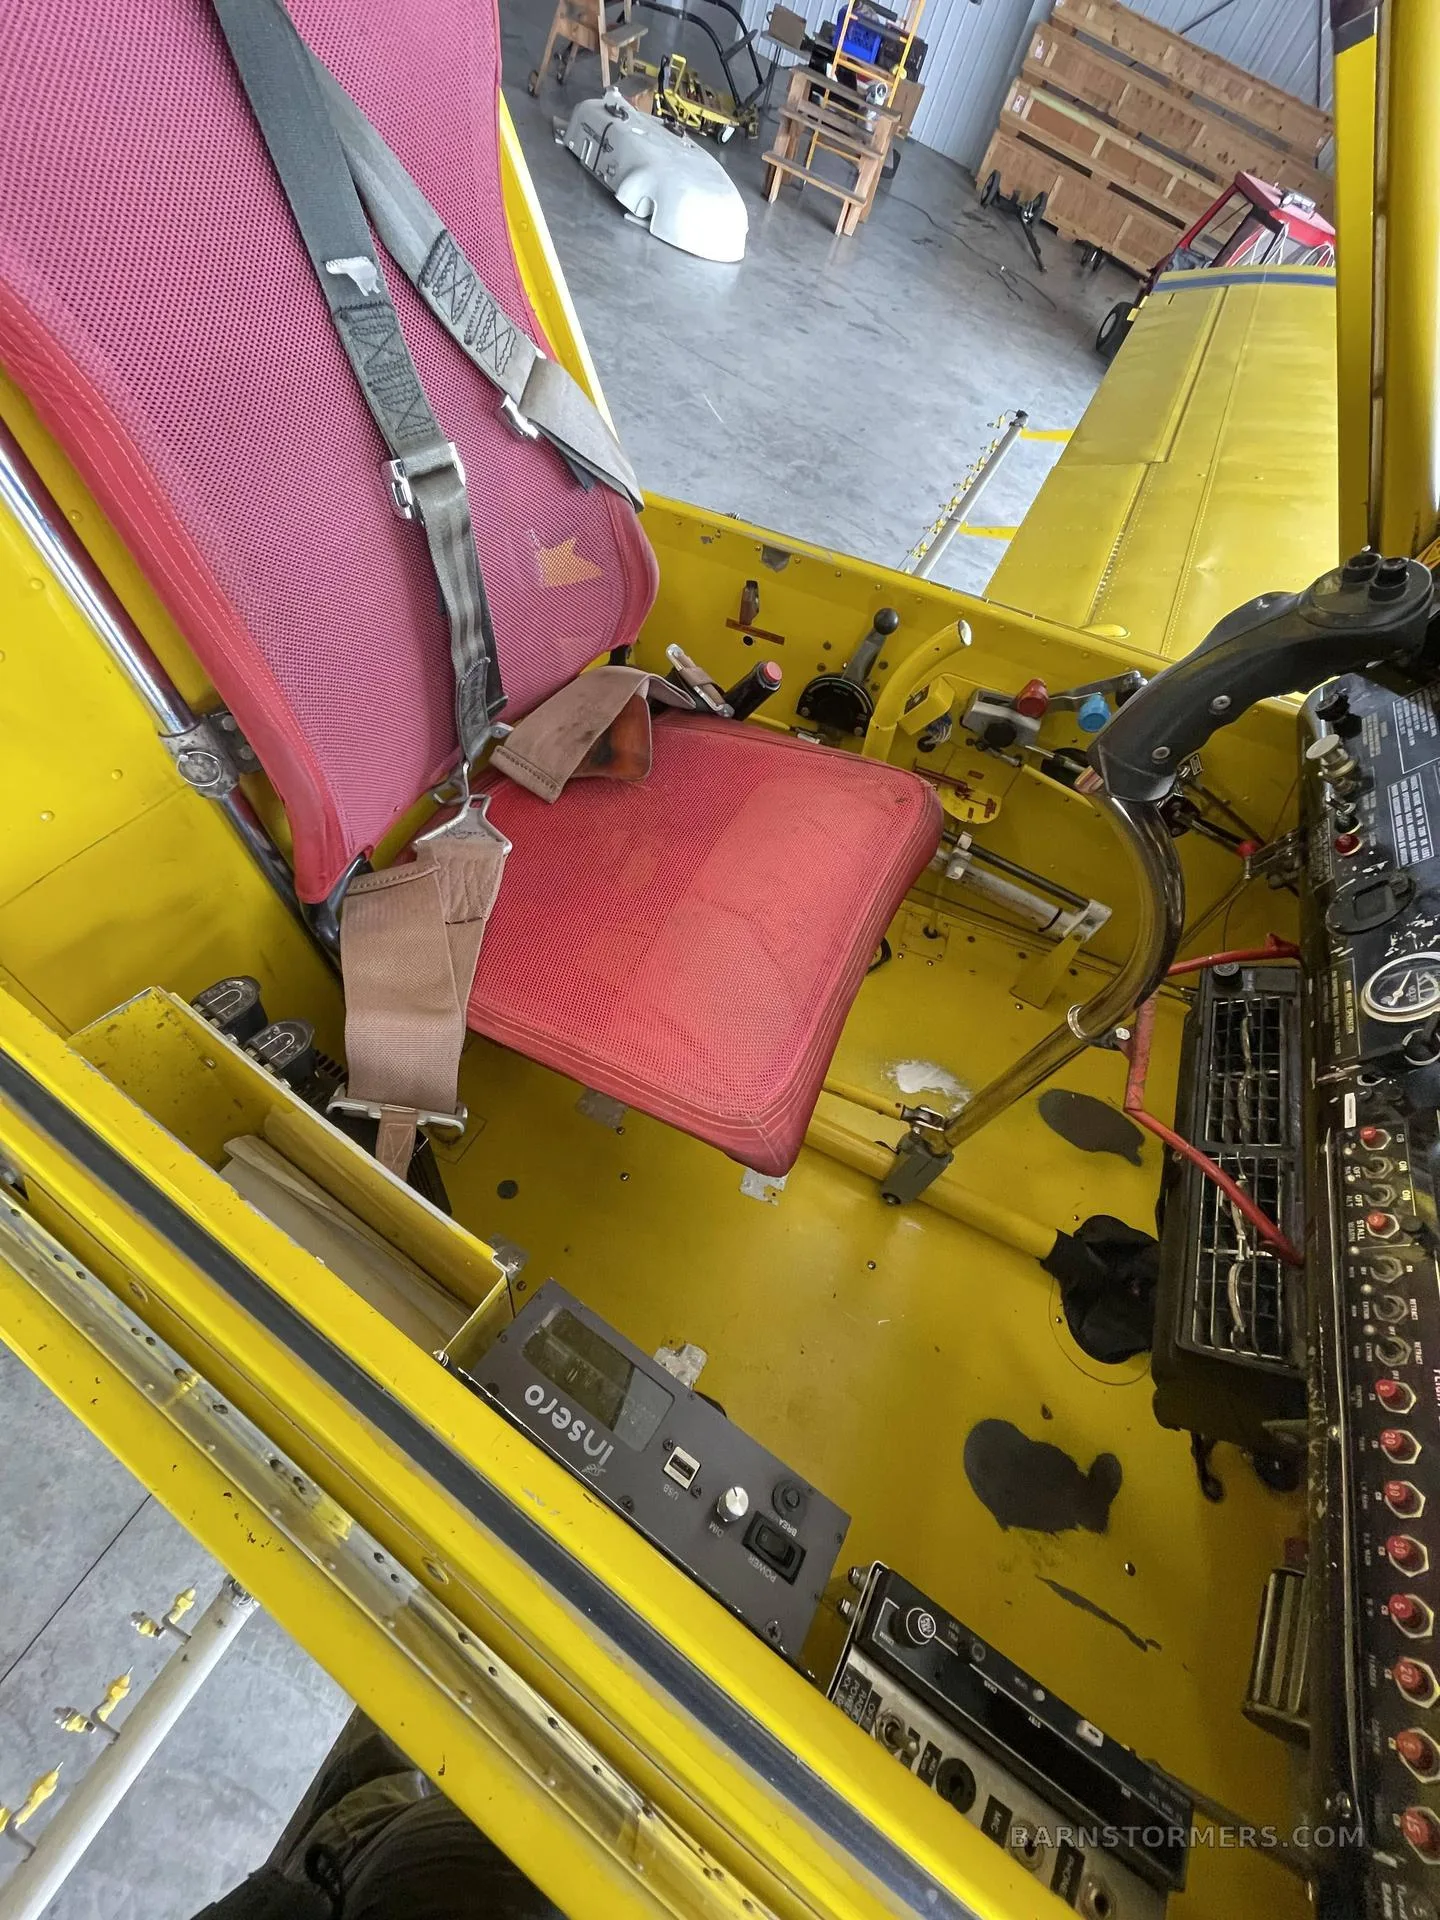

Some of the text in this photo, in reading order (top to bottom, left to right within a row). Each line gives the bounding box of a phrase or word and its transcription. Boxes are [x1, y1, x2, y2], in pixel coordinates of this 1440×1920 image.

[1353, 1166, 1361, 1178] OFF
[1399, 1160, 1408, 1171] ON
[1346, 1195, 1354, 1207] ALT
[1355, 1194, 1363, 1207] OFF
[1402, 1189, 1411, 1201] ON
[1357, 1219, 1365, 1241] STALL
[524, 1384, 615, 1467] insero
[1384, 1432, 1396, 1445] 20
[663, 1484, 679, 1501] USB
[708, 1521, 724, 1538] DIM
[1394, 1540, 1406, 1554] 30
[748, 1556, 777, 1583] POWER
[1394, 1602, 1406, 1611] 5
[1400, 1665, 1413, 1682] 20
[1406, 1815, 1422, 1834] 15
